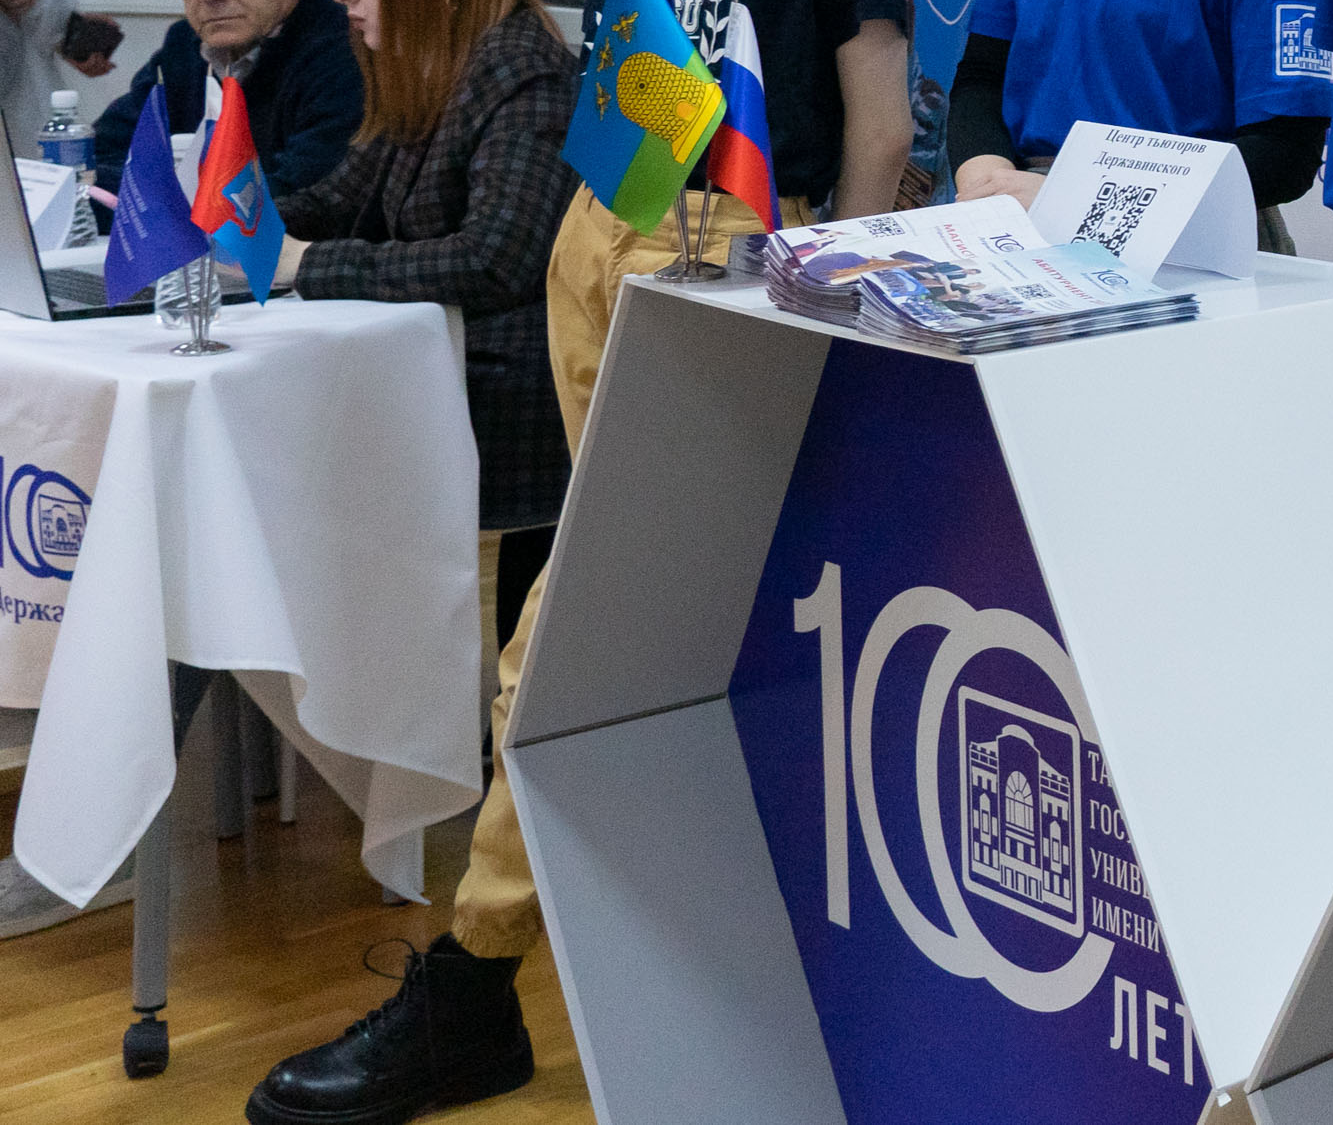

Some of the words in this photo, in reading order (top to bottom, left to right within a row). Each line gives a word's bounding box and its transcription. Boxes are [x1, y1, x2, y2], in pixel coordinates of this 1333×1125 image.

[1105, 129, 1144, 148] Центр
[1147, 137, 1207, 154] тьюторов
[1093, 151, 1190, 176] Державинского
[1091, 896, 1161, 954] ИМЕНИ
[1110, 975, 1194, 1086] ЛЕТ
